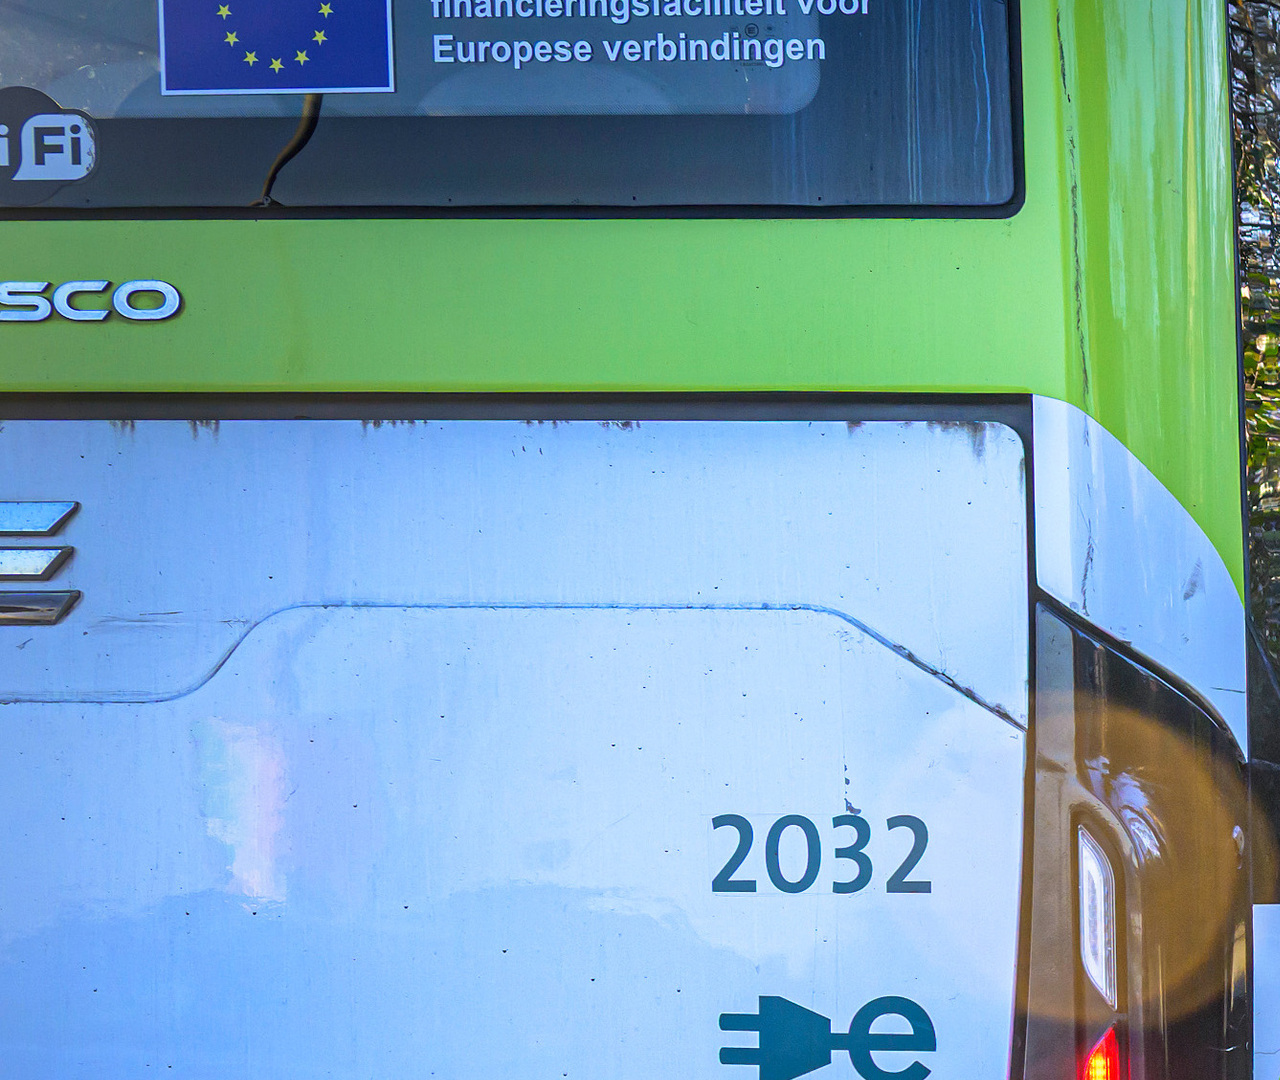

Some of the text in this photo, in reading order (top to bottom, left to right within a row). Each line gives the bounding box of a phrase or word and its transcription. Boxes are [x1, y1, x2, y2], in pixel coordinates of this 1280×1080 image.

[799, 0, 870, 15] voor
[433, 32, 826, 70] Europese verbindingen
[711, 814, 932, 894] 2032
